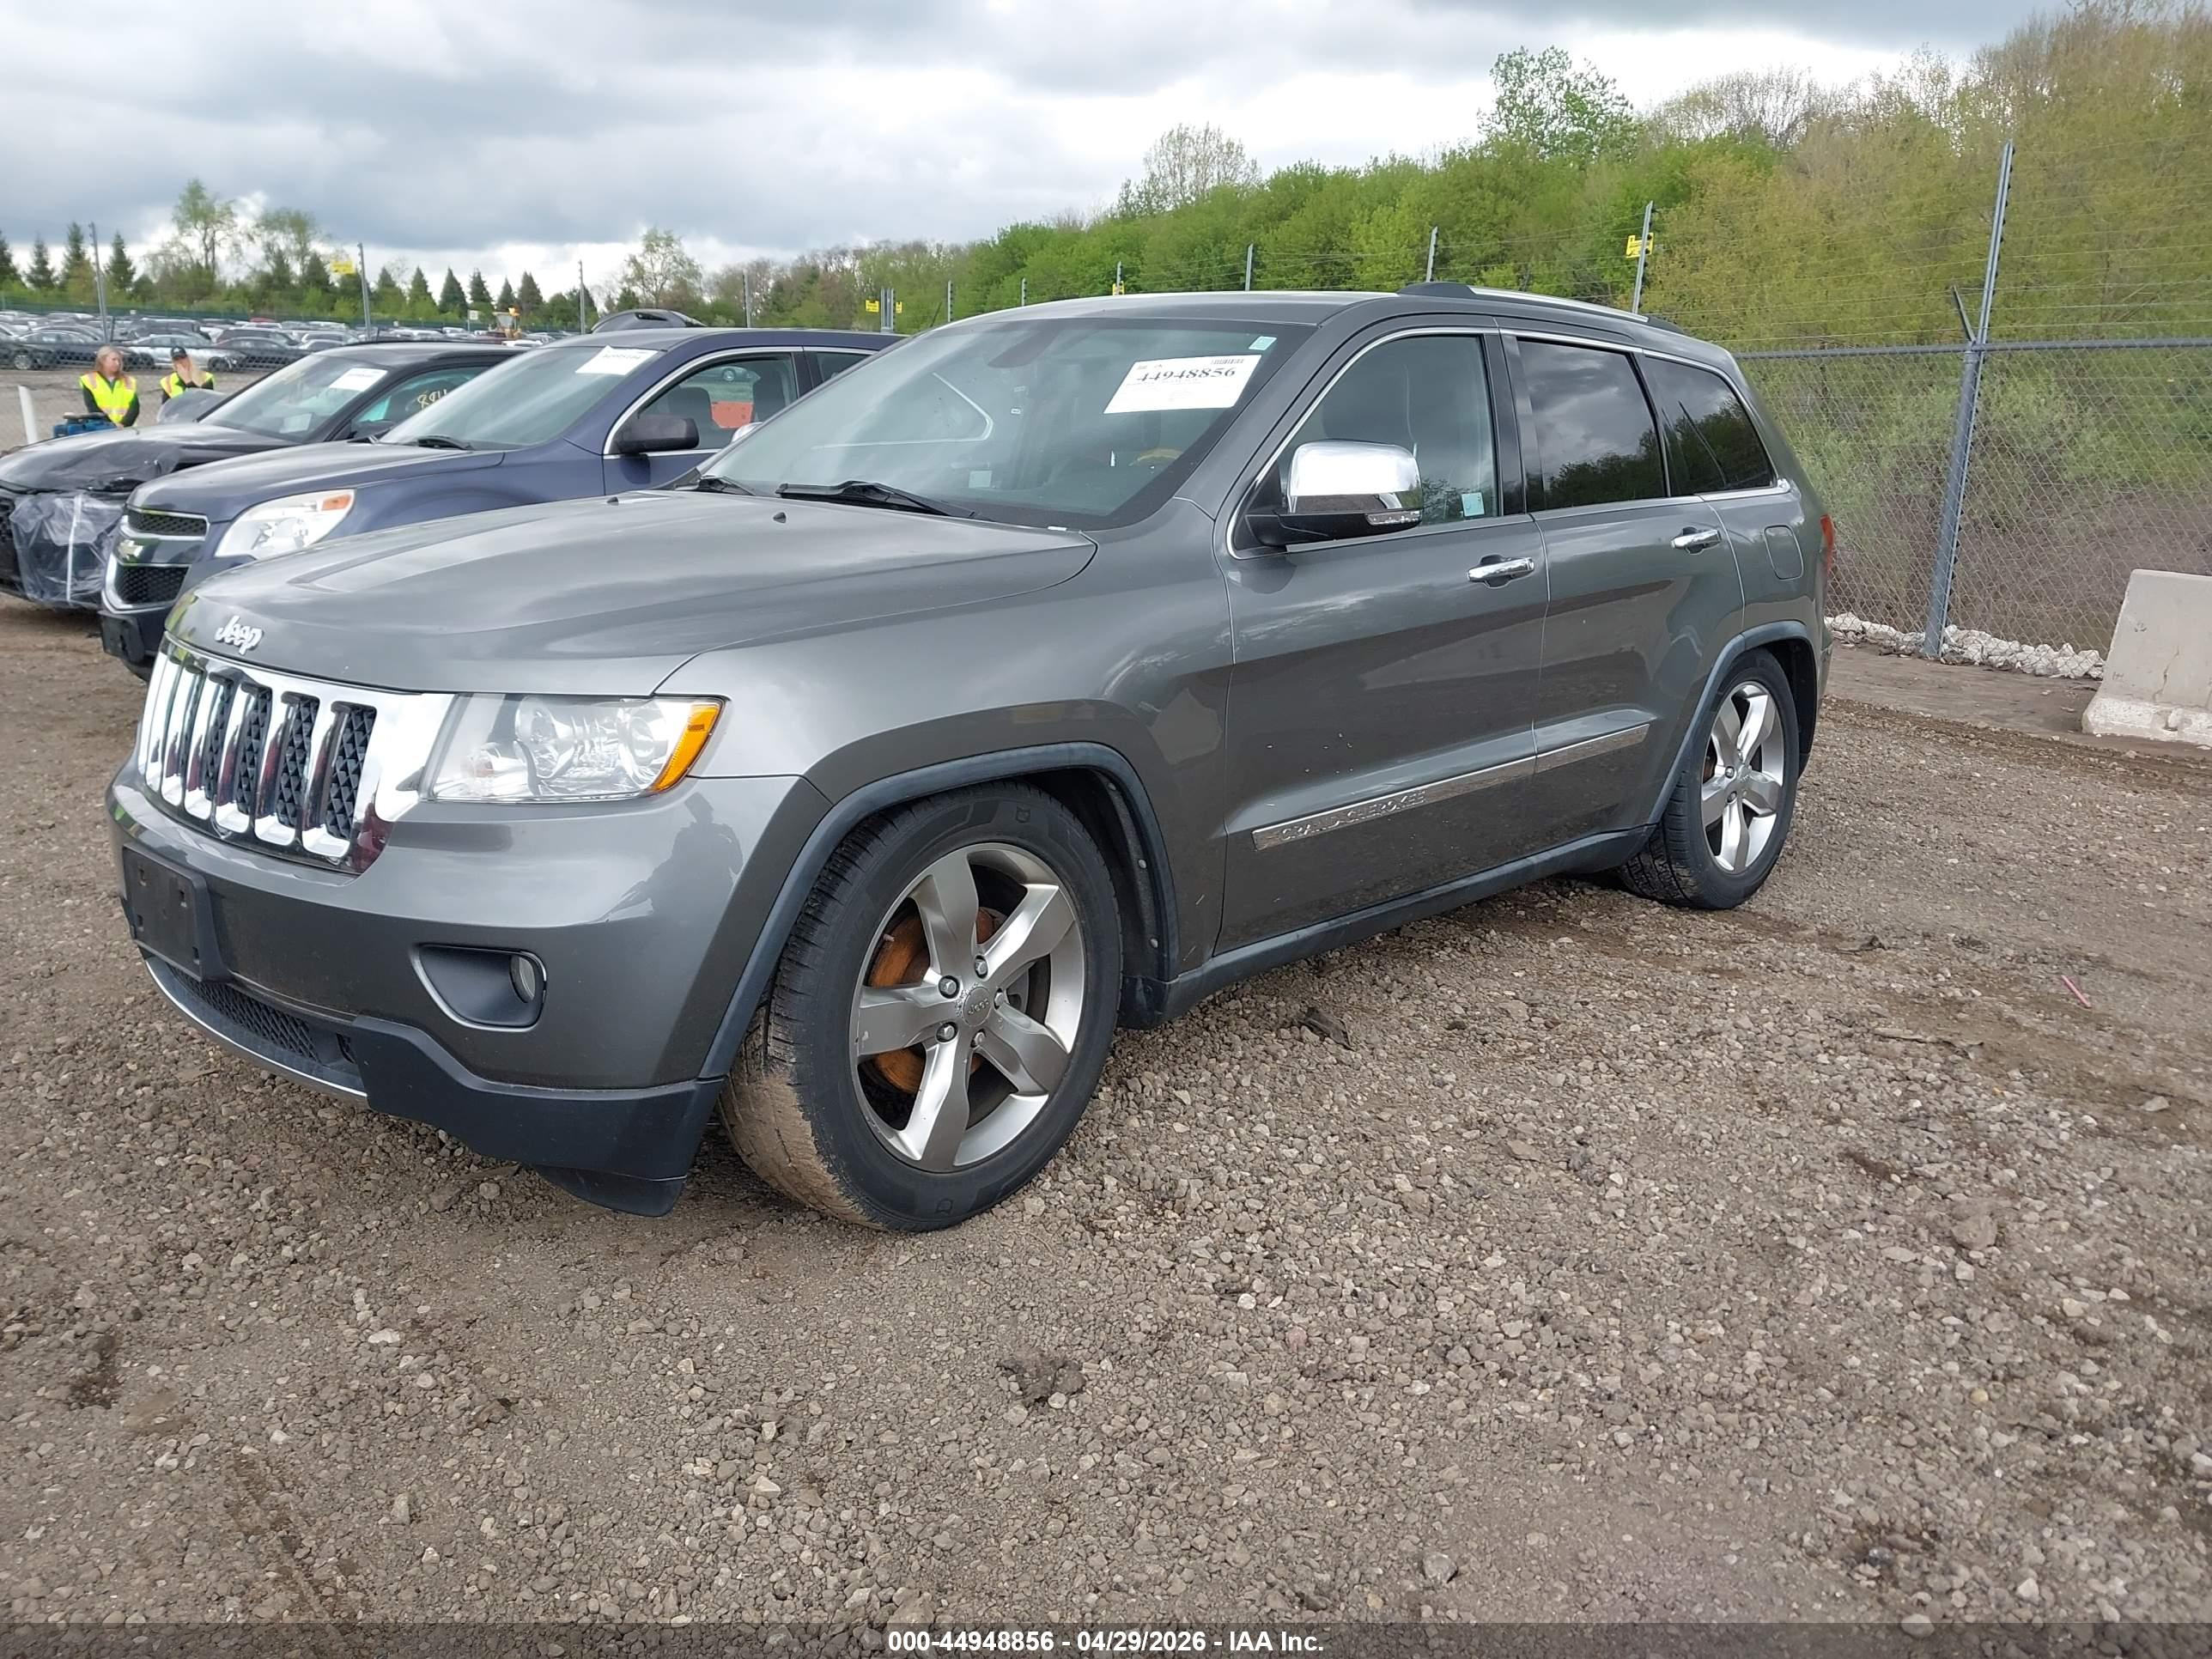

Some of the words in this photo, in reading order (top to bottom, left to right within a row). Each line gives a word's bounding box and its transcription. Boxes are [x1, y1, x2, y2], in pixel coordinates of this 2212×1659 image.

[1137, 367, 1237, 382] 44948856
[215, 615, 264, 655] Jeep
[1281, 816, 1341, 841] GRAND
[1346, 789, 1427, 824] CHEROKEE
